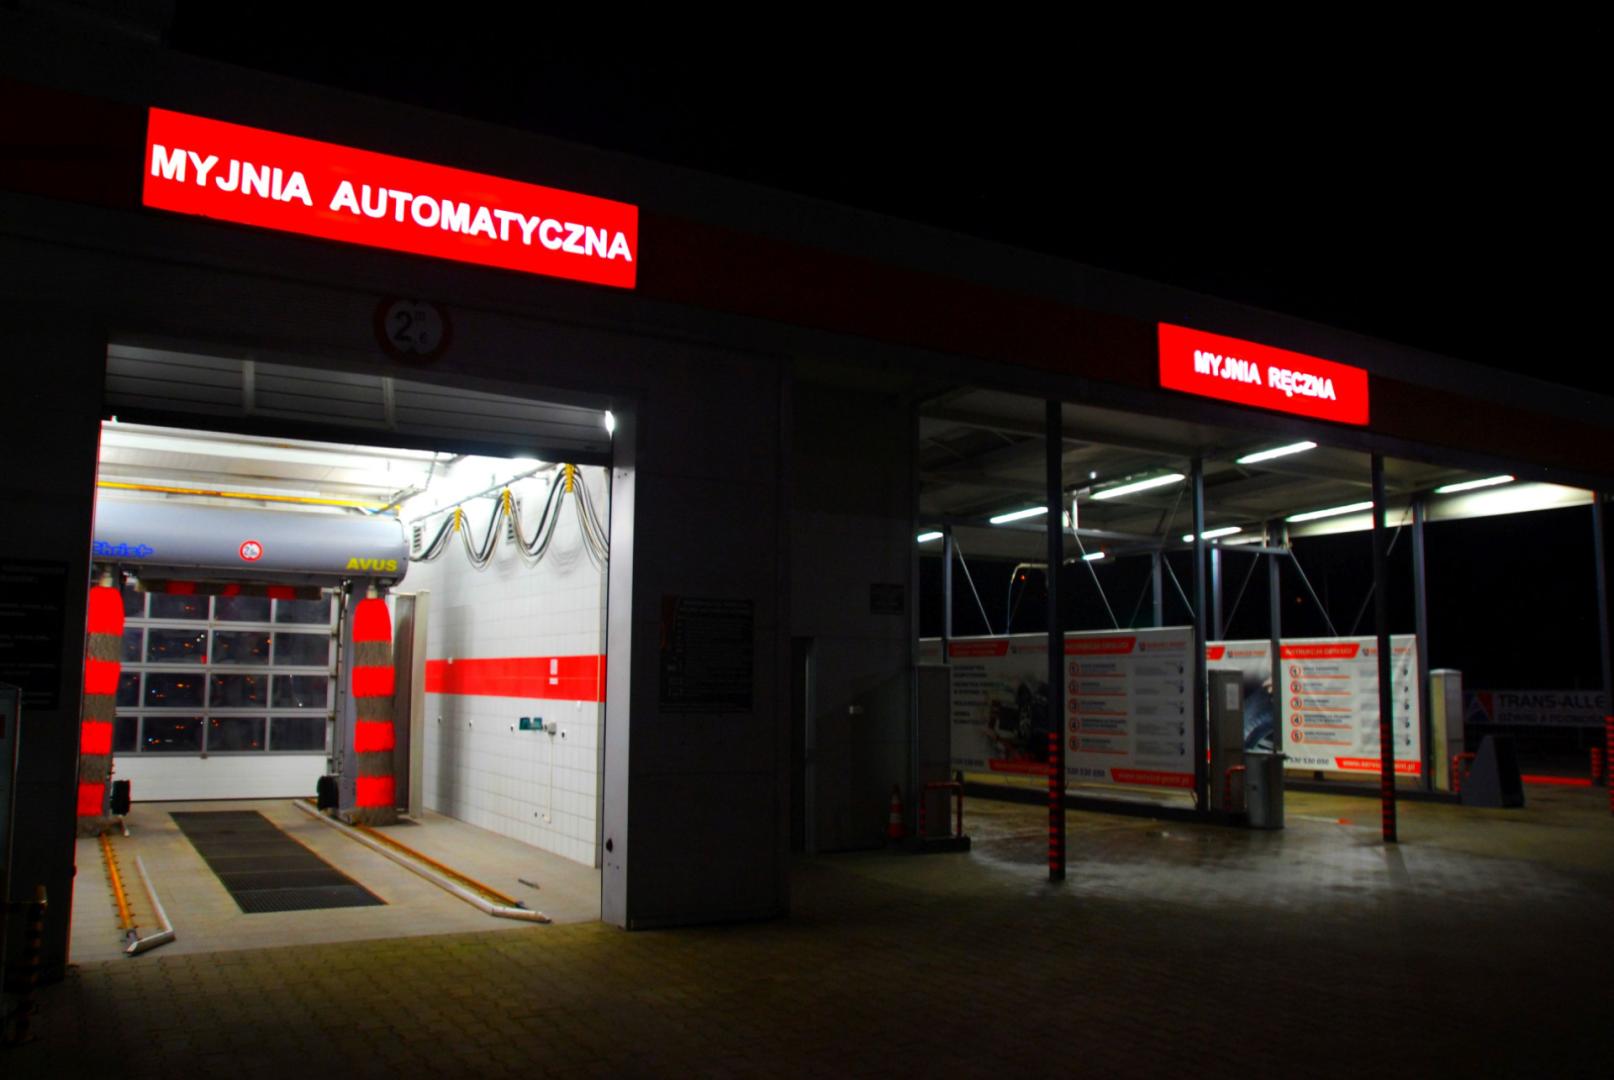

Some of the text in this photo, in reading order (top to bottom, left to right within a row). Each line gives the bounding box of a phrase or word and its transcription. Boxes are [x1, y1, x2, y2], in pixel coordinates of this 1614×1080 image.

[151, 144, 632, 262] MYJNIA AUTOMATYCZNA
[1193, 350, 1337, 401] MYJNIA RĘCZNA
[346, 557, 398, 573] AVUS
